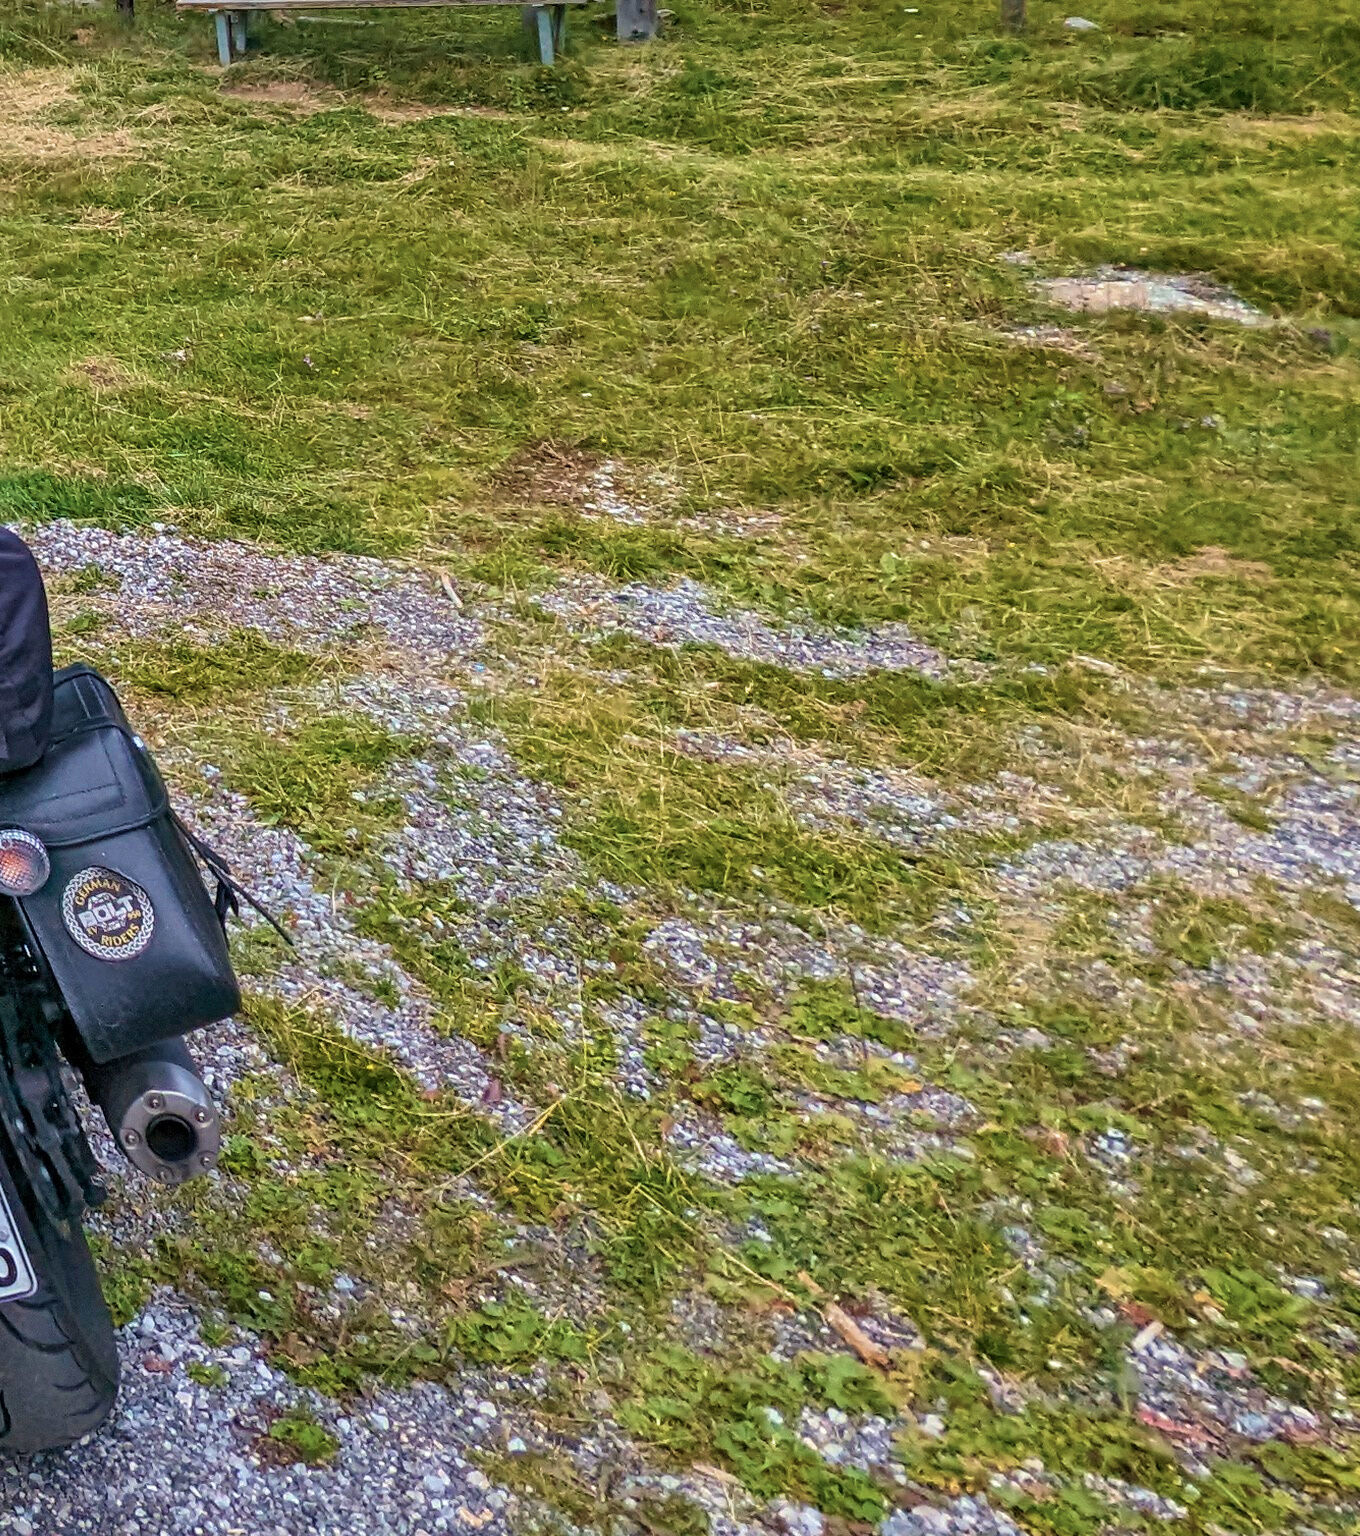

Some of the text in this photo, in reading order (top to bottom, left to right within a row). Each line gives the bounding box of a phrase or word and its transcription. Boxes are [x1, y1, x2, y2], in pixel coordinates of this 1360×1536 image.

[75, 879, 121, 906] GERMAN
[78, 895, 133, 929] BOLT
[101, 923, 140, 947] RIDERS
